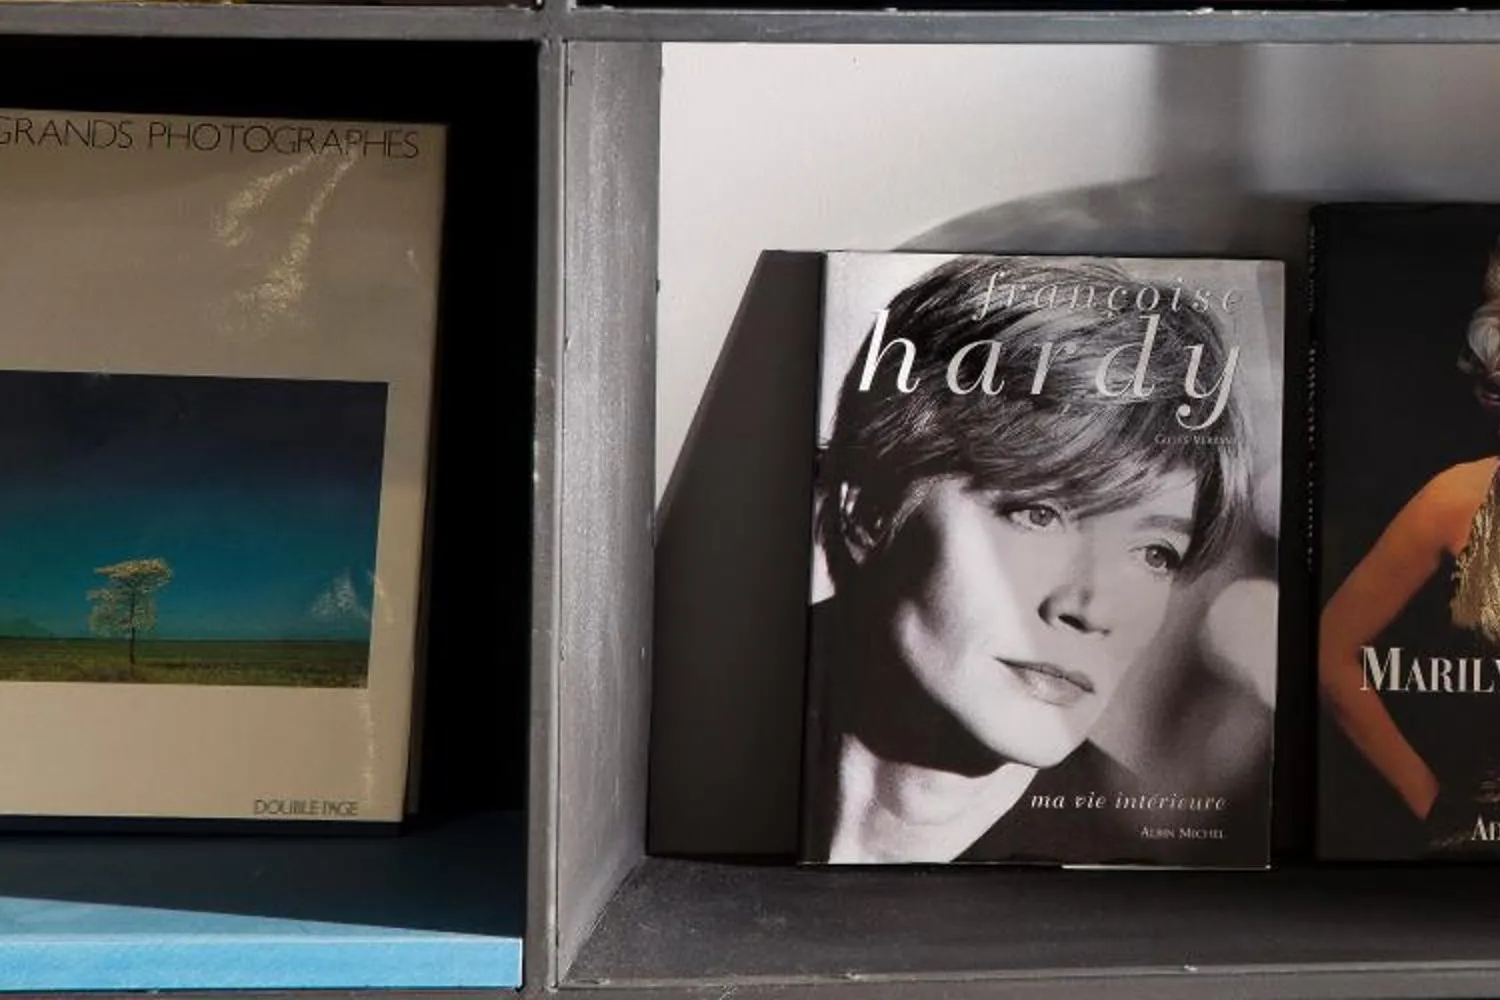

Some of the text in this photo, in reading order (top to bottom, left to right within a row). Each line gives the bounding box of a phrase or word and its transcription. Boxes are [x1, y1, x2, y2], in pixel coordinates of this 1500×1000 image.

[148, 121, 419, 160] PHOTOGRAPHES
[971, 270, 1244, 321] françoise
[857, 308, 1242, 431] hardy
[1030, 791, 1228, 812] ma vie intérieure
